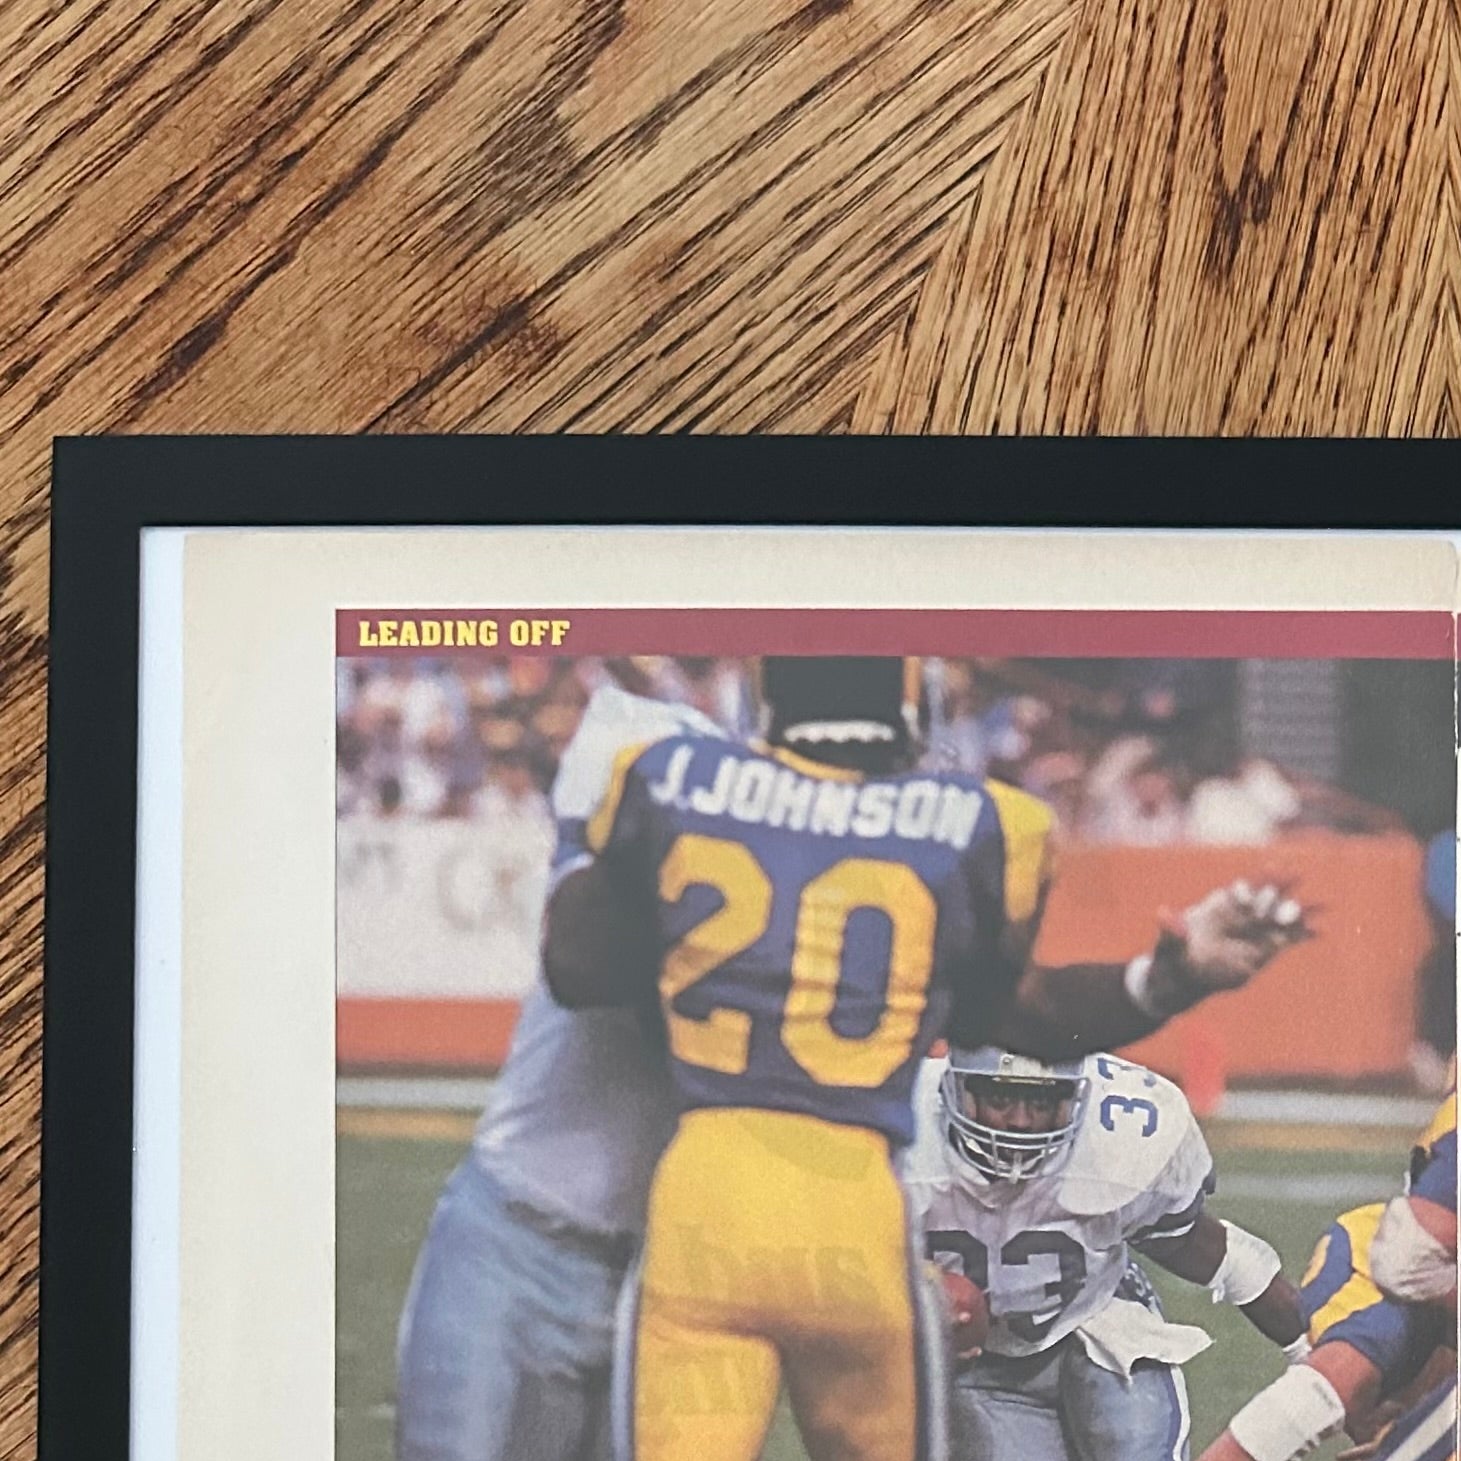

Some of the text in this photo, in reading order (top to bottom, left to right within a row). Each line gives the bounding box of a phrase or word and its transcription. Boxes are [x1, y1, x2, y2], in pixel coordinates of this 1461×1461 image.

[359, 619, 571, 647] LEADING OFF
[657, 833, 938, 1088] 20
